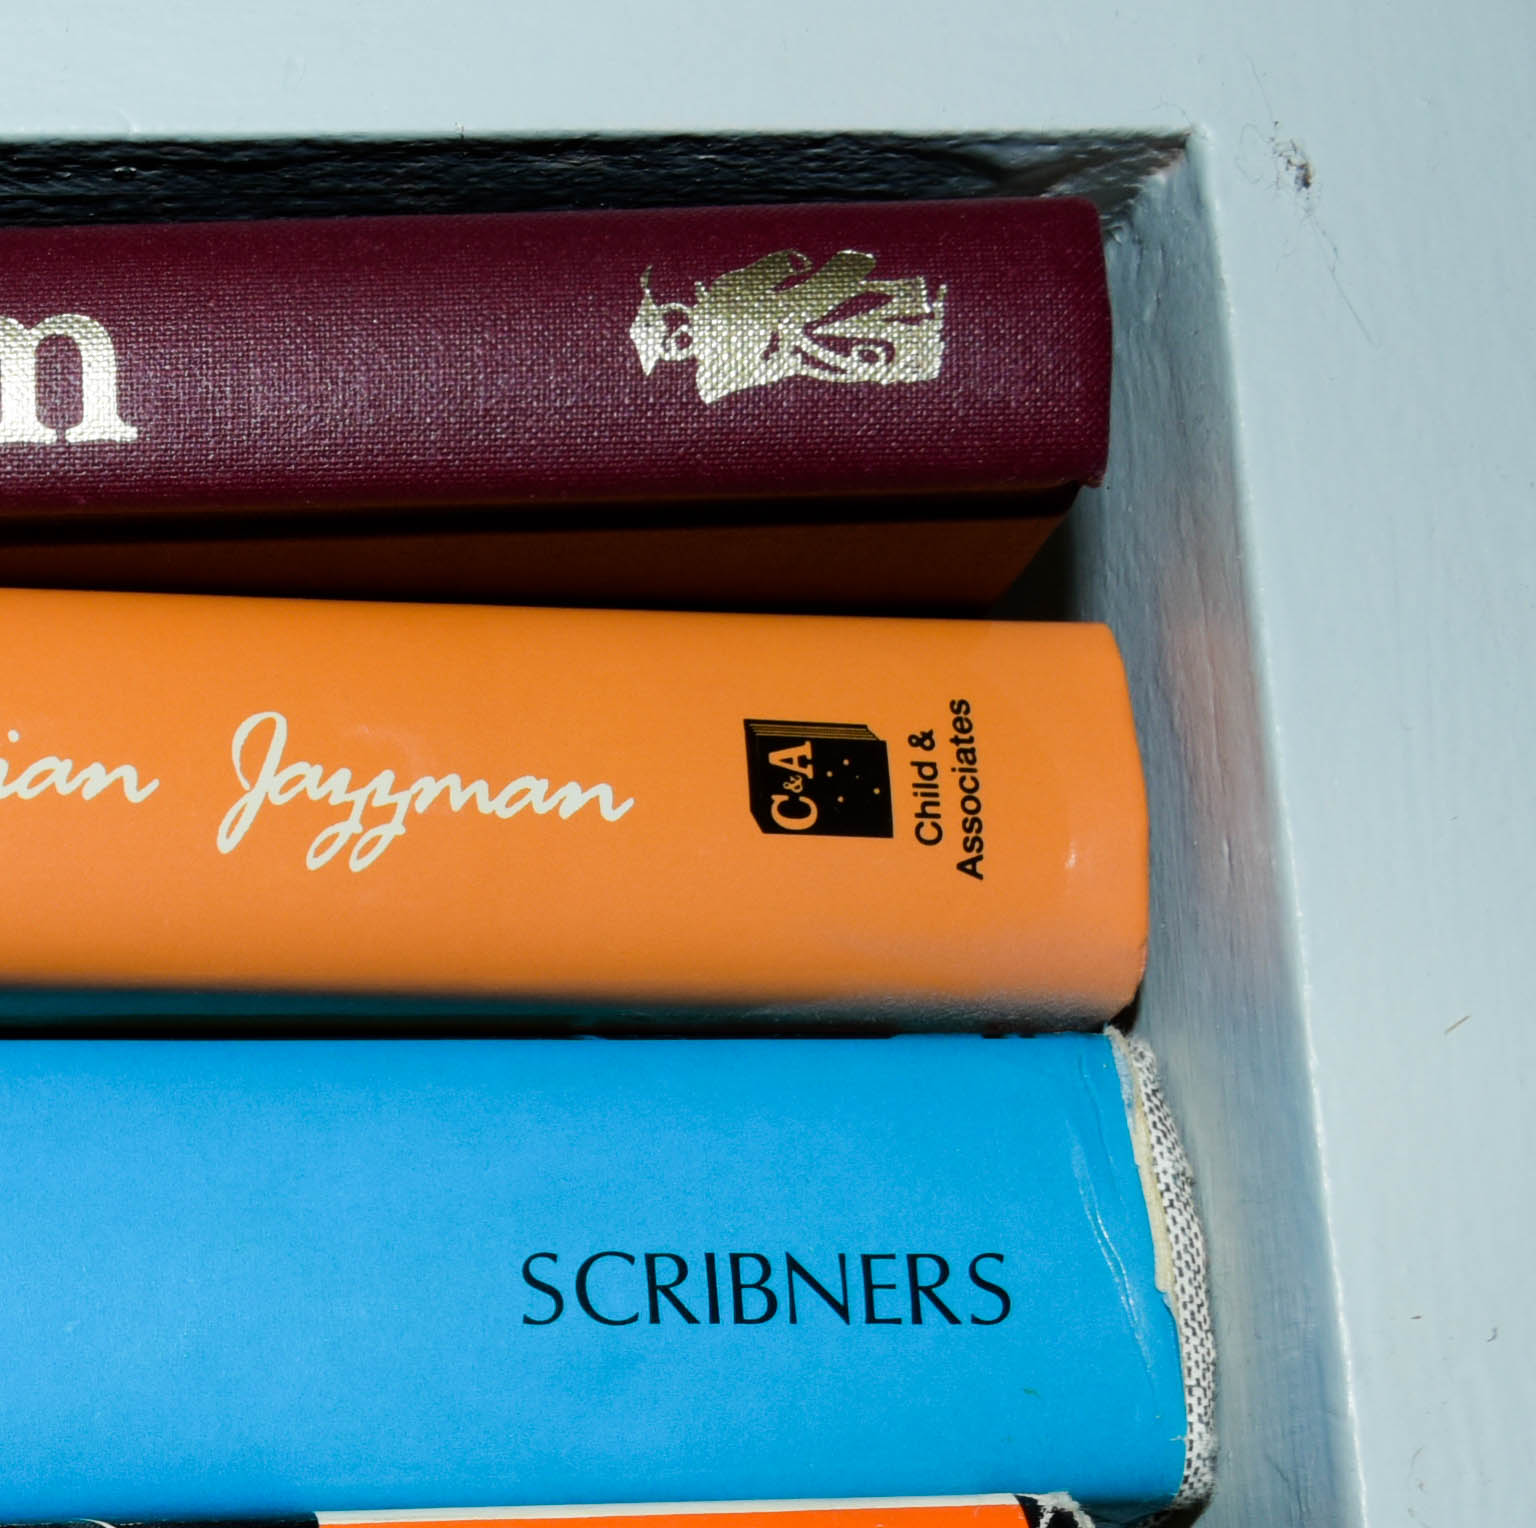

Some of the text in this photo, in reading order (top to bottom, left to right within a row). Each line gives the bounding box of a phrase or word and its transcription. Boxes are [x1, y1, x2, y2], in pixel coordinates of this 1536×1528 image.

[217, 711, 634, 873] Jazzman
[768, 740, 818, 831] C&A
[907, 729, 943, 846] Child &
[949, 698, 984, 880] Associates
[521, 1250, 1012, 1327] SCRIBNERS
